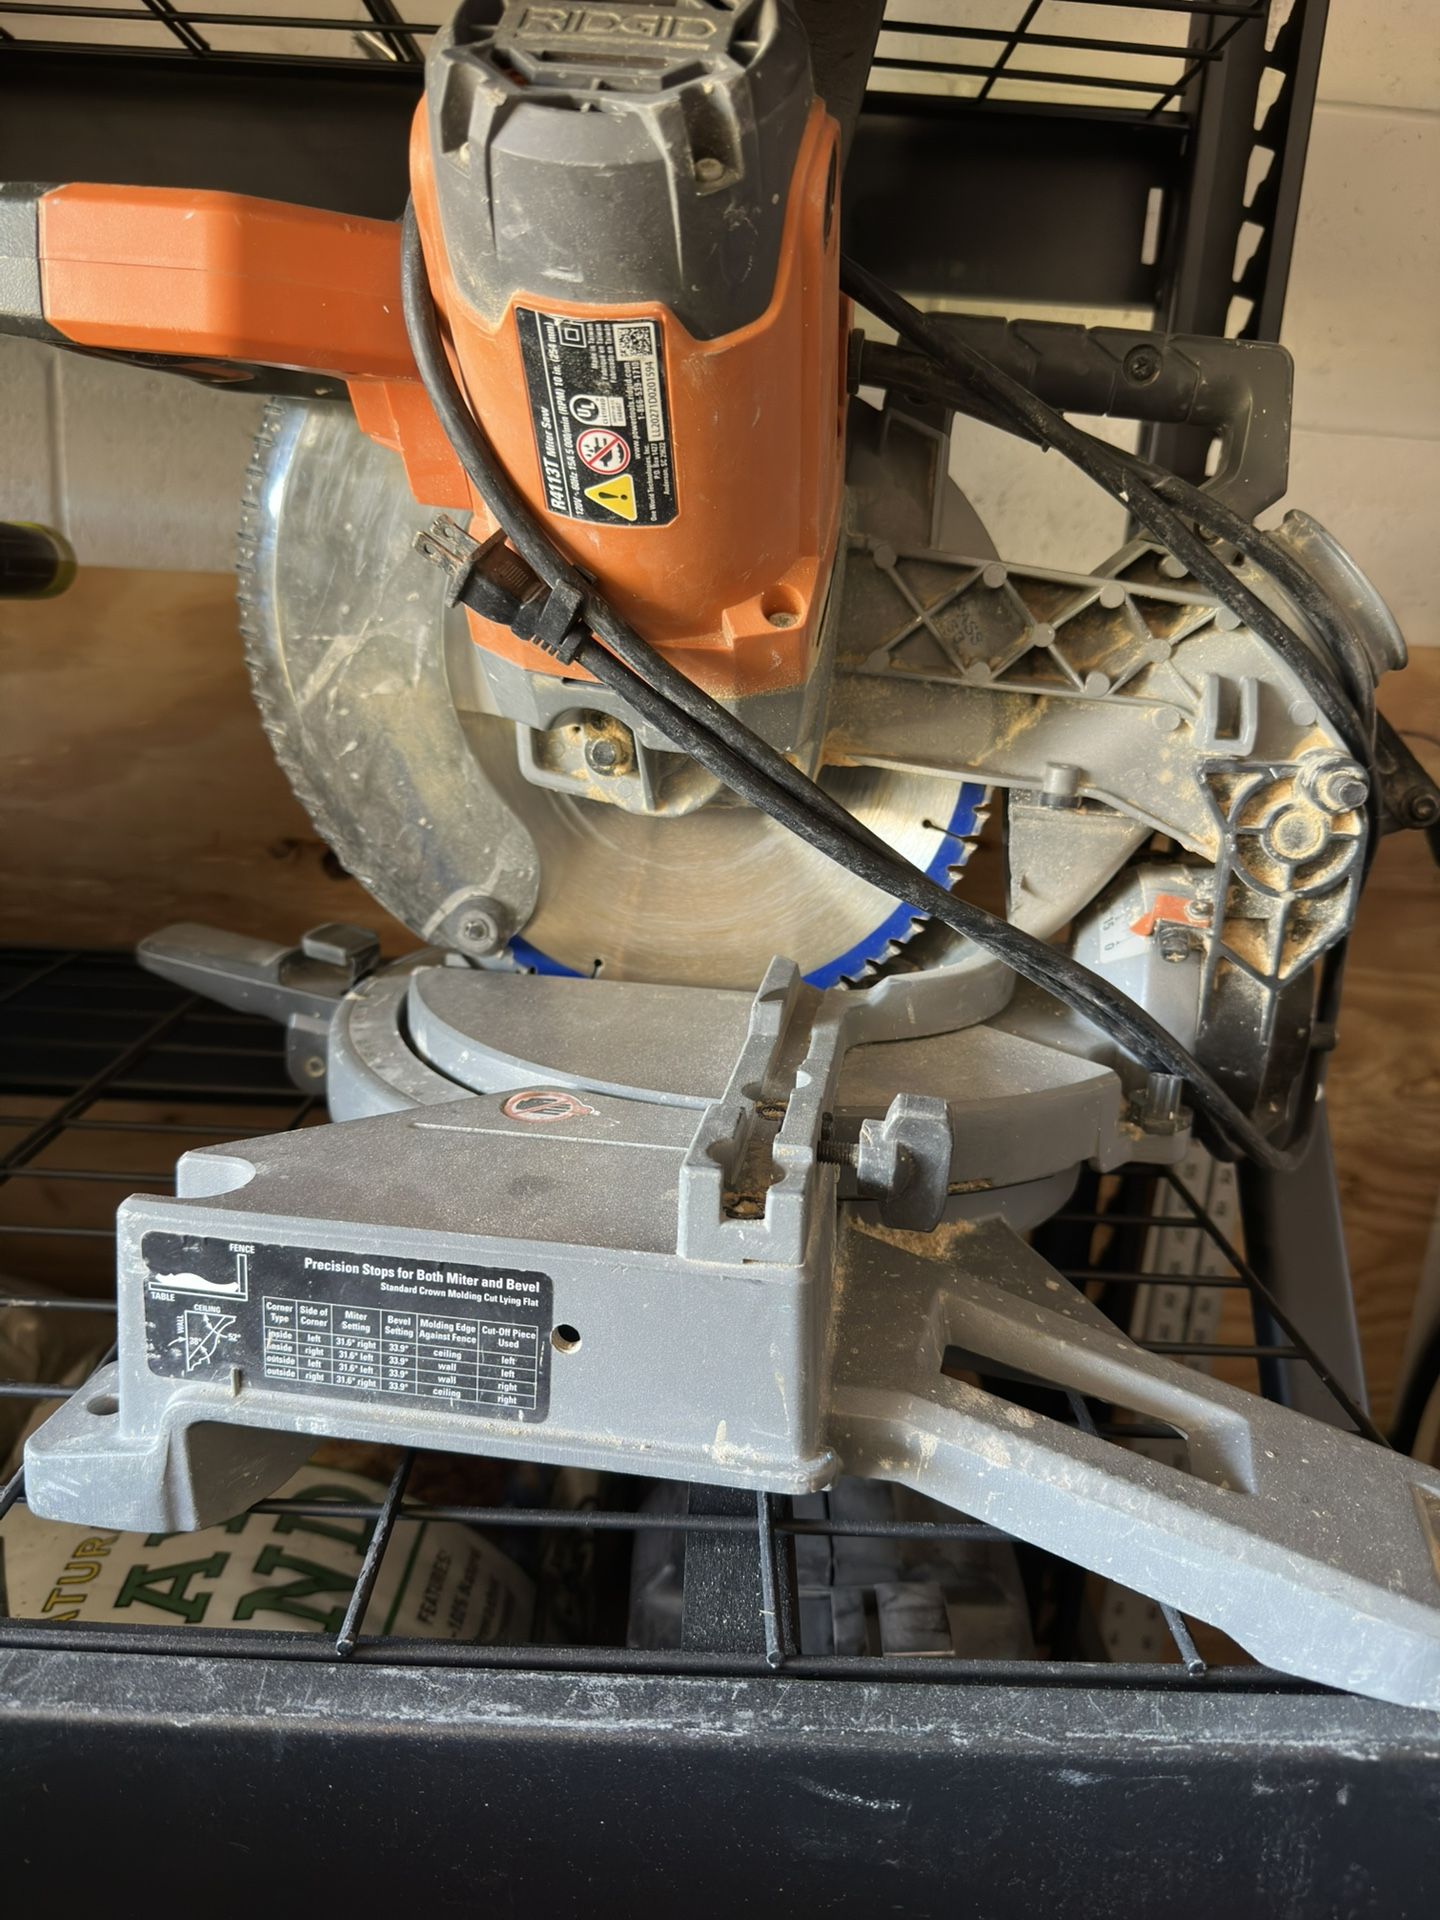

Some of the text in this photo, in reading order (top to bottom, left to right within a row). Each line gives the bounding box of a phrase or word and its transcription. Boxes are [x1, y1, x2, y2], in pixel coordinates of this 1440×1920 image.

[518, 6, 717, 40] RIDGID
[543, 322, 556, 343] mm)
[587, 323, 595, 344] Taiwan
[547, 343, 560, 362] (254
[598, 345, 605, 353] en
[552, 365, 562, 375] in.
[553, 376, 563, 387] 10
[631, 361, 645, 420] 1-866-539-1710
[554, 388, 569, 415] (RPM)
[645, 361, 661, 438] LL20271D0201594
[576, 402, 596, 418] UL
[624, 361, 641, 459] www.powertools.ridgid.com
[541, 406, 567, 510] R4113T Miter Saw
[567, 456, 577, 471] 15A
[660, 458, 668, 467] SC
[573, 497, 584, 515] 120V
[648, 493, 656, 510] World
[229, 1243, 255, 1254] FENCE
[304, 1257, 540, 1293] Precision Stops for Both Miter and Bevel
[151, 1291, 175, 1301] TABLE
[380, 1282, 539, 1307] Standard Crown Molding Cut Lying Flat
[194, 1304, 221, 1314] CEILING
[266, 1302, 293, 1312] Corner
[300, 1306, 328, 1316] Side of
[270, 1313, 289, 1324] Type
[344, 1310, 367, 1321] Miter
[388, 1315, 411, 1326] Bevel
[176, 1315, 184, 1334] WALL
[300, 1316, 328, 1327] Corner
[420, 1319, 476, 1335] Molding Edge
[341, 1321, 370, 1334] Setting
[385, 1326, 414, 1338] Setting
[482, 1326, 536, 1339] Cut-Off Piece
[268, 1329, 293, 1339] inside
[307, 1334, 321, 1343] left
[419, 1331, 477, 1344] Against Fence
[336, 1337, 376, 1350] 31.6° right
[389, 1343, 409, 1353] 33.9°
[498, 1338, 519, 1349] Used
[305, 1347, 324, 1357] right
[339, 1350, 374, 1362] 31.6° left
[433, 1349, 462, 1361] ceiling
[266, 1355, 295, 1365] outside
[307, 1359, 321, 1368] left
[389, 1356, 409, 1365] 33.9°
[501, 1357, 516, 1366] left
[339, 1363, 374, 1374] 31.6° left
[438, 1362, 456, 1371] wall
[266, 1368, 296, 1378] outside
[305, 1372, 324, 1382] right
[389, 1369, 408, 1378] 33.9°
[501, 1369, 515, 1378] left
[336, 1375, 376, 1389] 31.6° right
[438, 1375, 456, 1384] wall
[388, 1382, 408, 1391] 33.9°
[498, 1382, 517, 1393] right
[433, 1387, 461, 1399] ceiling
[498, 1395, 517, 1405] right
